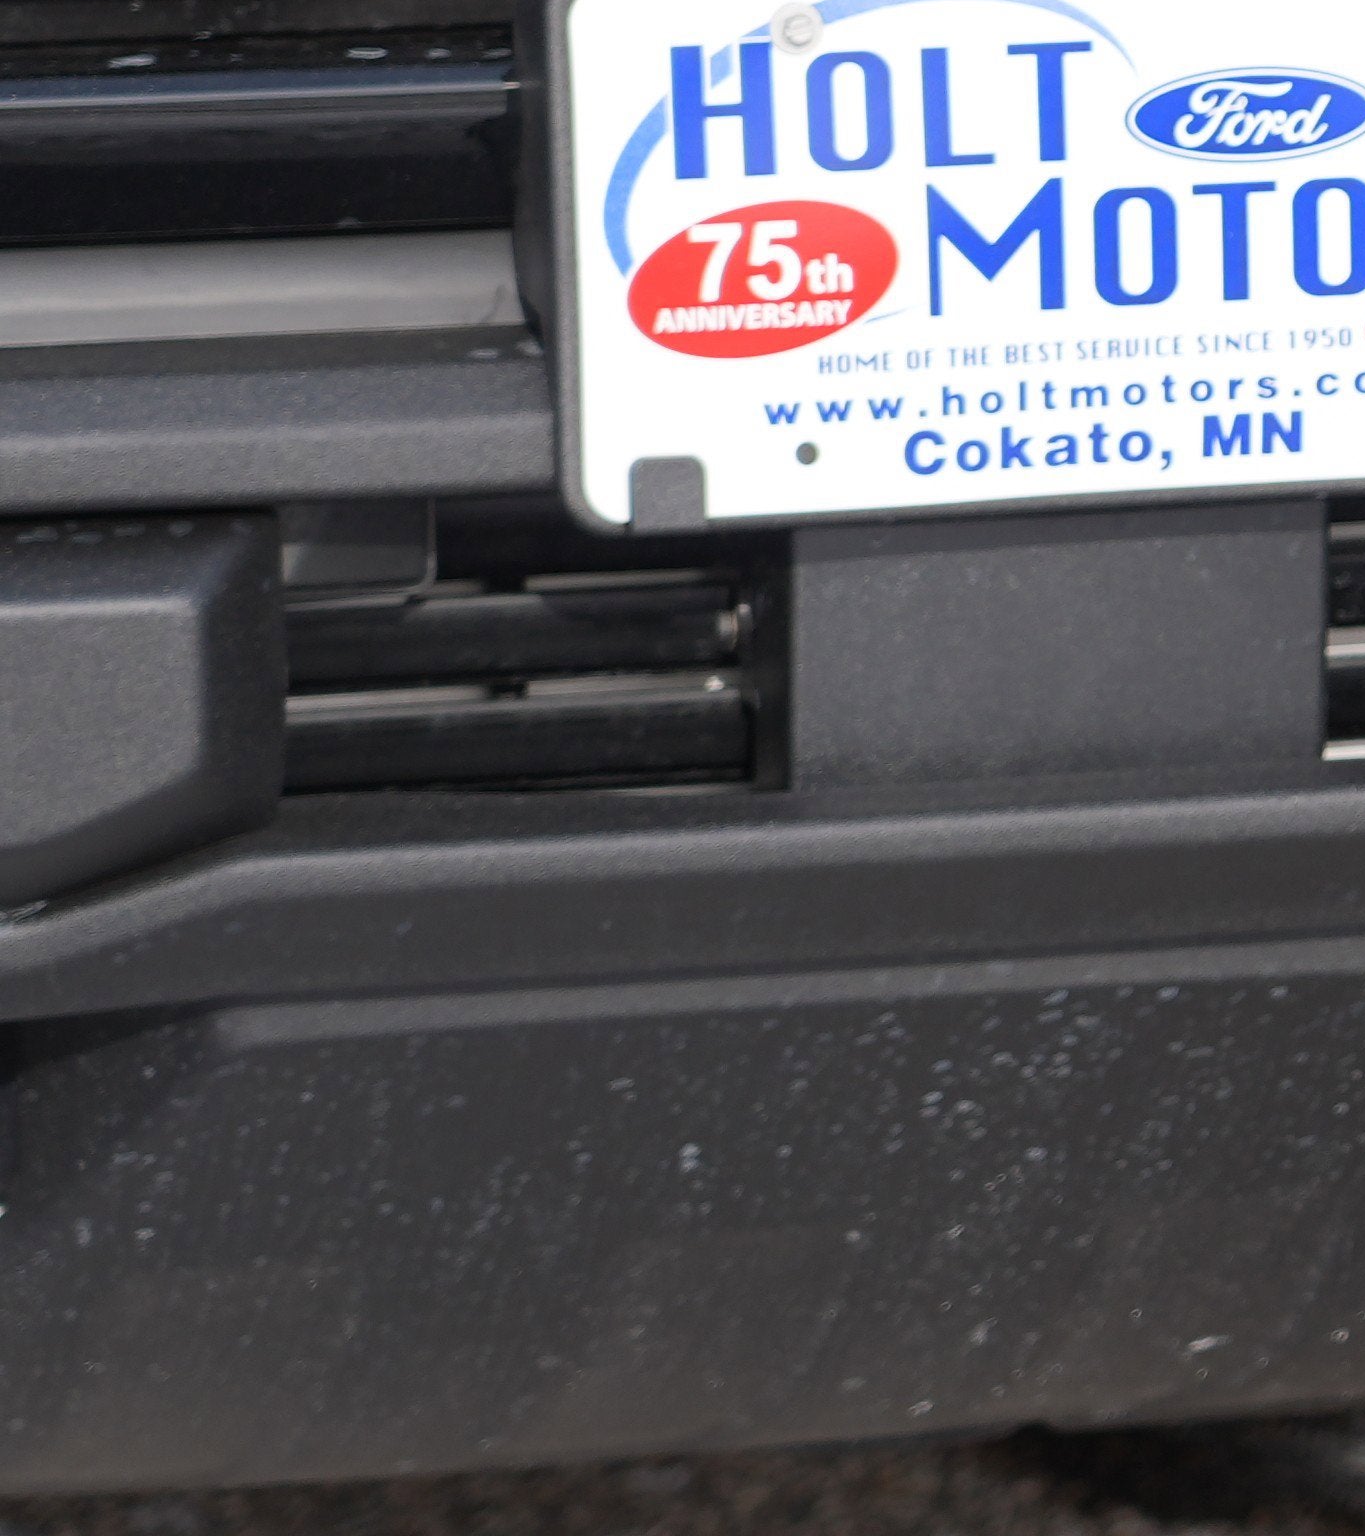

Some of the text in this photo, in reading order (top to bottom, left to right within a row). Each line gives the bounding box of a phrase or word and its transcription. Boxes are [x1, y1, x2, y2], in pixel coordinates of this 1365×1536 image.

[671, 41, 1092, 180] HOLT
[1174, 79, 1332, 148] Ford
[688, 220, 854, 303] 75th
[652, 298, 854, 336] ANNIVERSARY
[817, 327, 1353, 375] HOME OF THE BEST SERVICE SINCE 1950
[904, 410, 1304, 476] Cokato, MN
